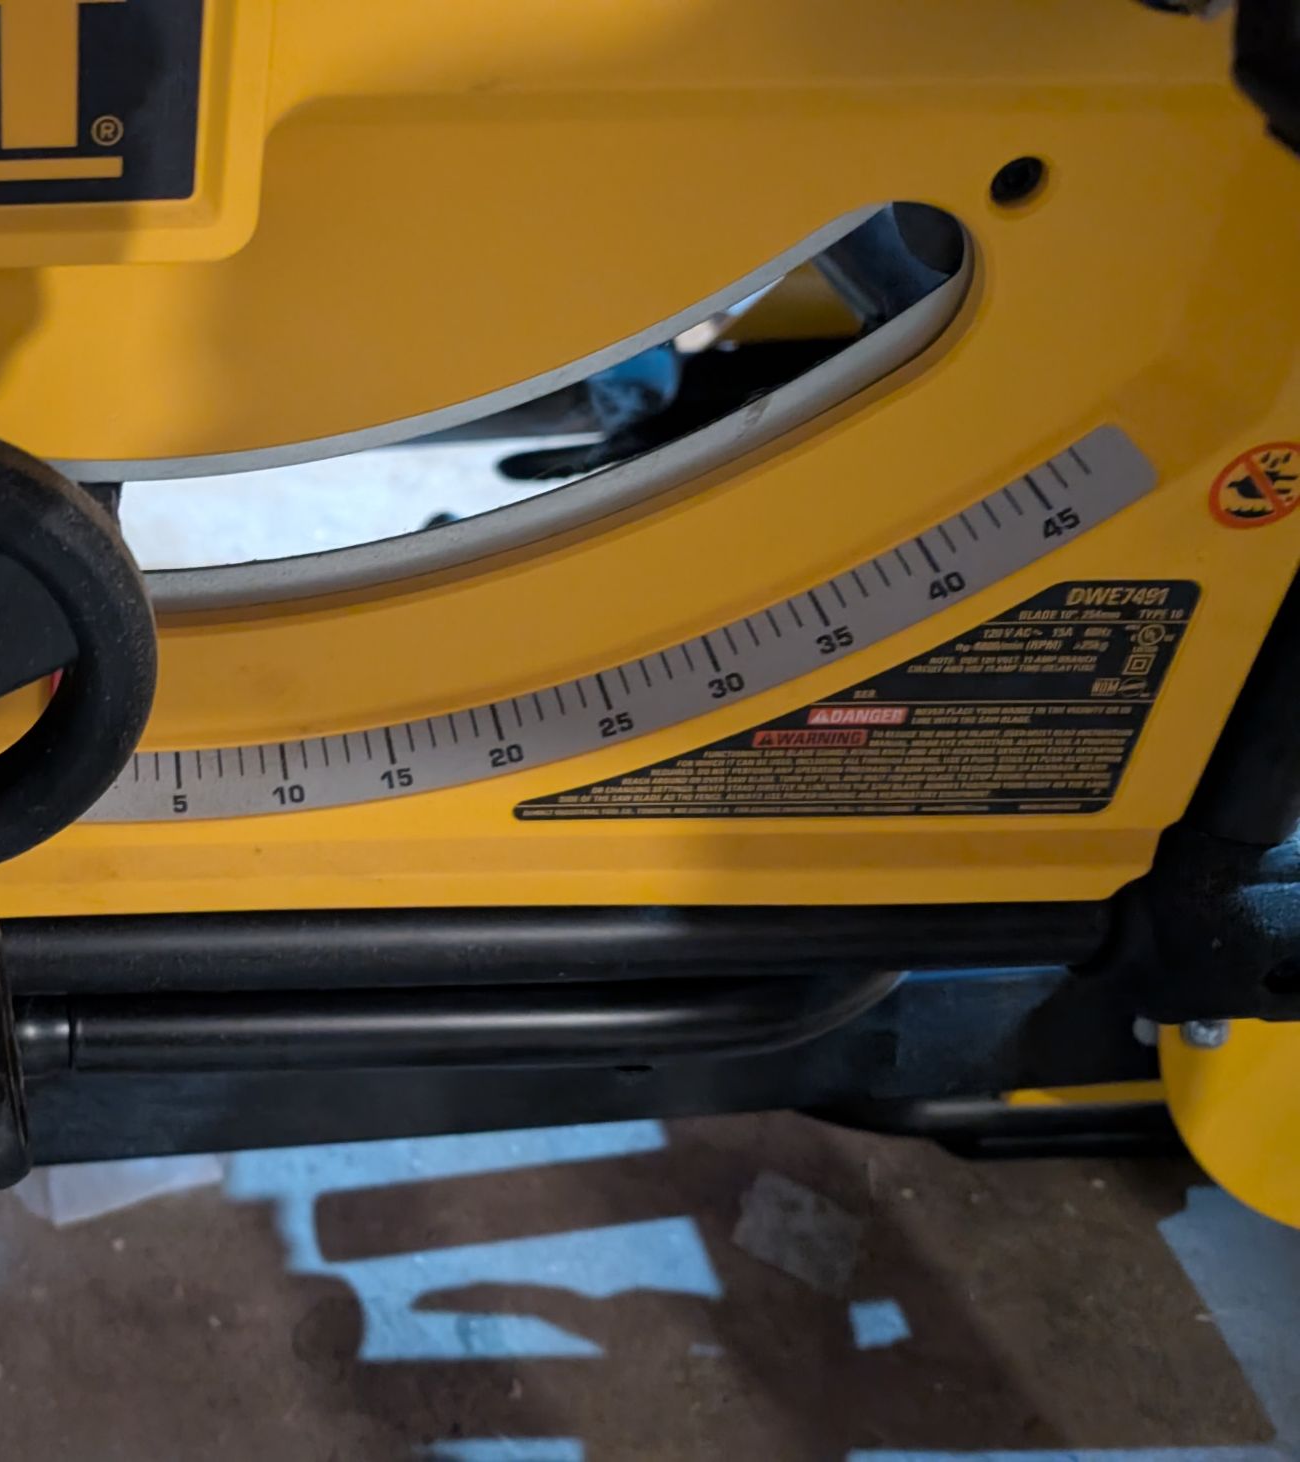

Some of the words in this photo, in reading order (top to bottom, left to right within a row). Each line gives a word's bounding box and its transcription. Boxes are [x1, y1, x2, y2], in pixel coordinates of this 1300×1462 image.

[1065, 587, 1170, 606] DWE7491
[172, 794, 188, 814] 5
[272, 784, 305, 805] 10
[380, 767, 414, 790] 15
[488, 743, 525, 768] 20
[598, 711, 634, 738] 25
[707, 672, 745, 699] 30
[815, 625, 854, 655] 35
[928, 571, 966, 600] 40
[1043, 507, 1081, 539] 45
[830, 707, 903, 722] DANGER
[777, 731, 862, 745] WARNING
